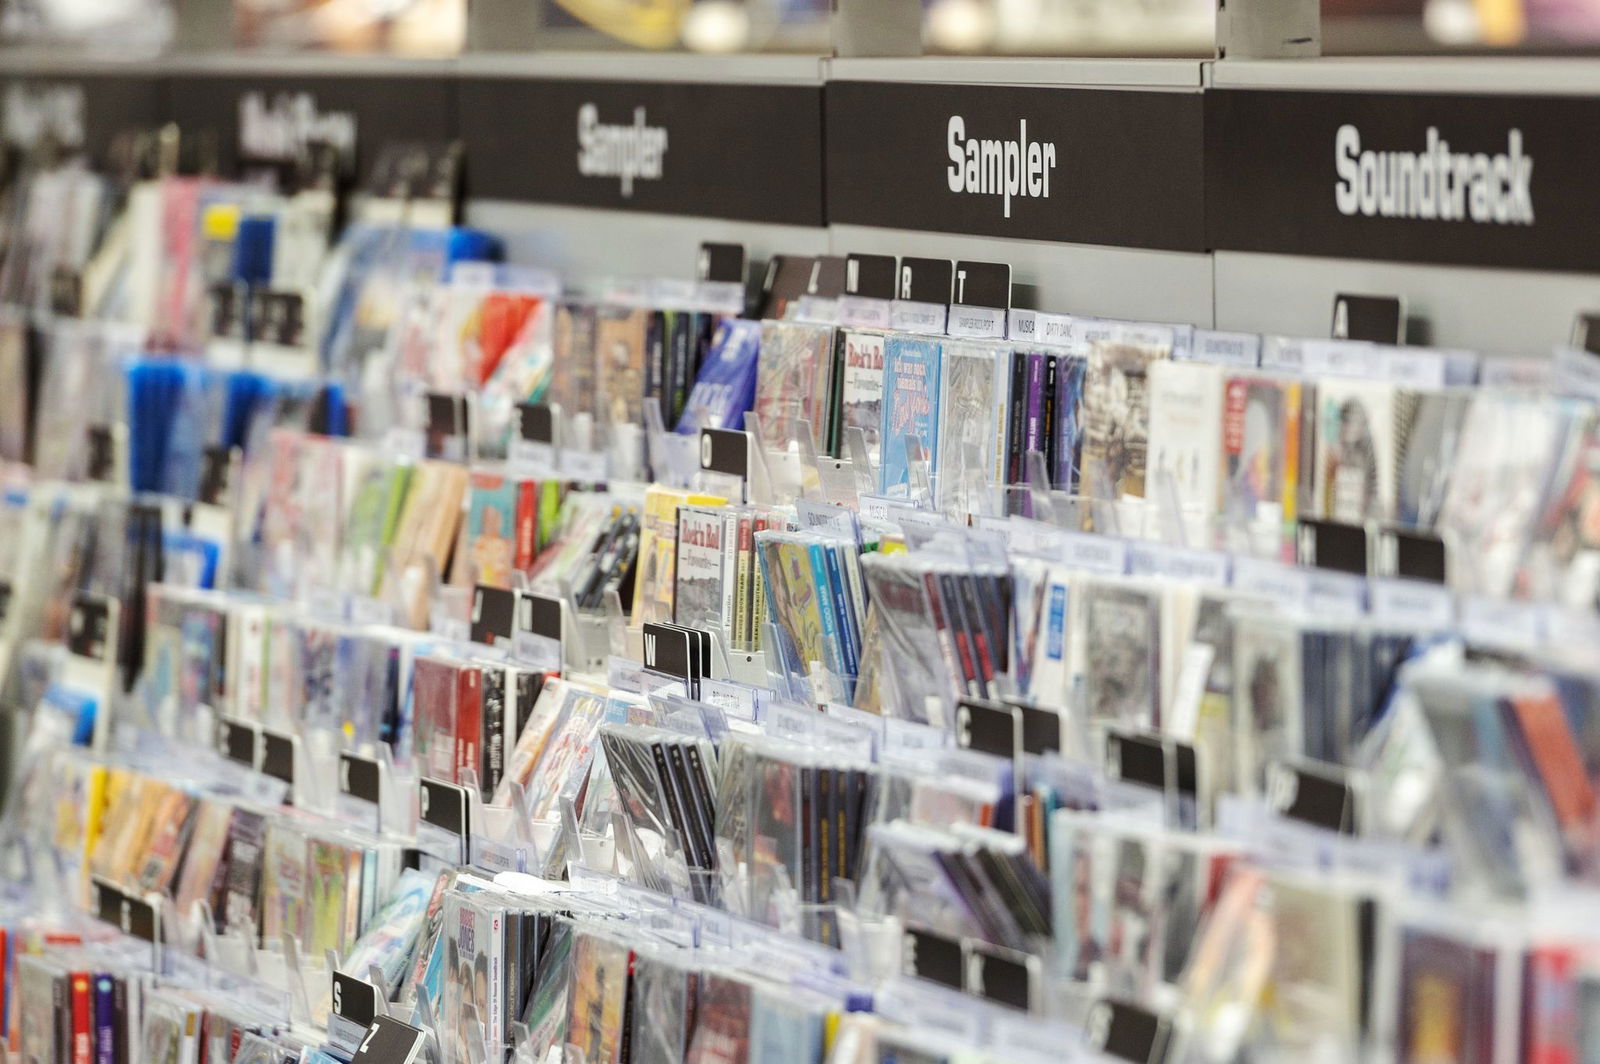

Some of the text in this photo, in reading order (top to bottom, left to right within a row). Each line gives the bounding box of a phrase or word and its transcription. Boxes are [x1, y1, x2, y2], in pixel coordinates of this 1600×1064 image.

[577, 102, 669, 197] Sampler
[947, 115, 1057, 218] Sampler
[1336, 124, 1535, 225] Soundtrack
[902, 266, 912, 299] R
[958, 270, 967, 303] T
[644, 633, 656, 667] W
[334, 981, 341, 1015] S
[359, 1022, 380, 1053] Z
